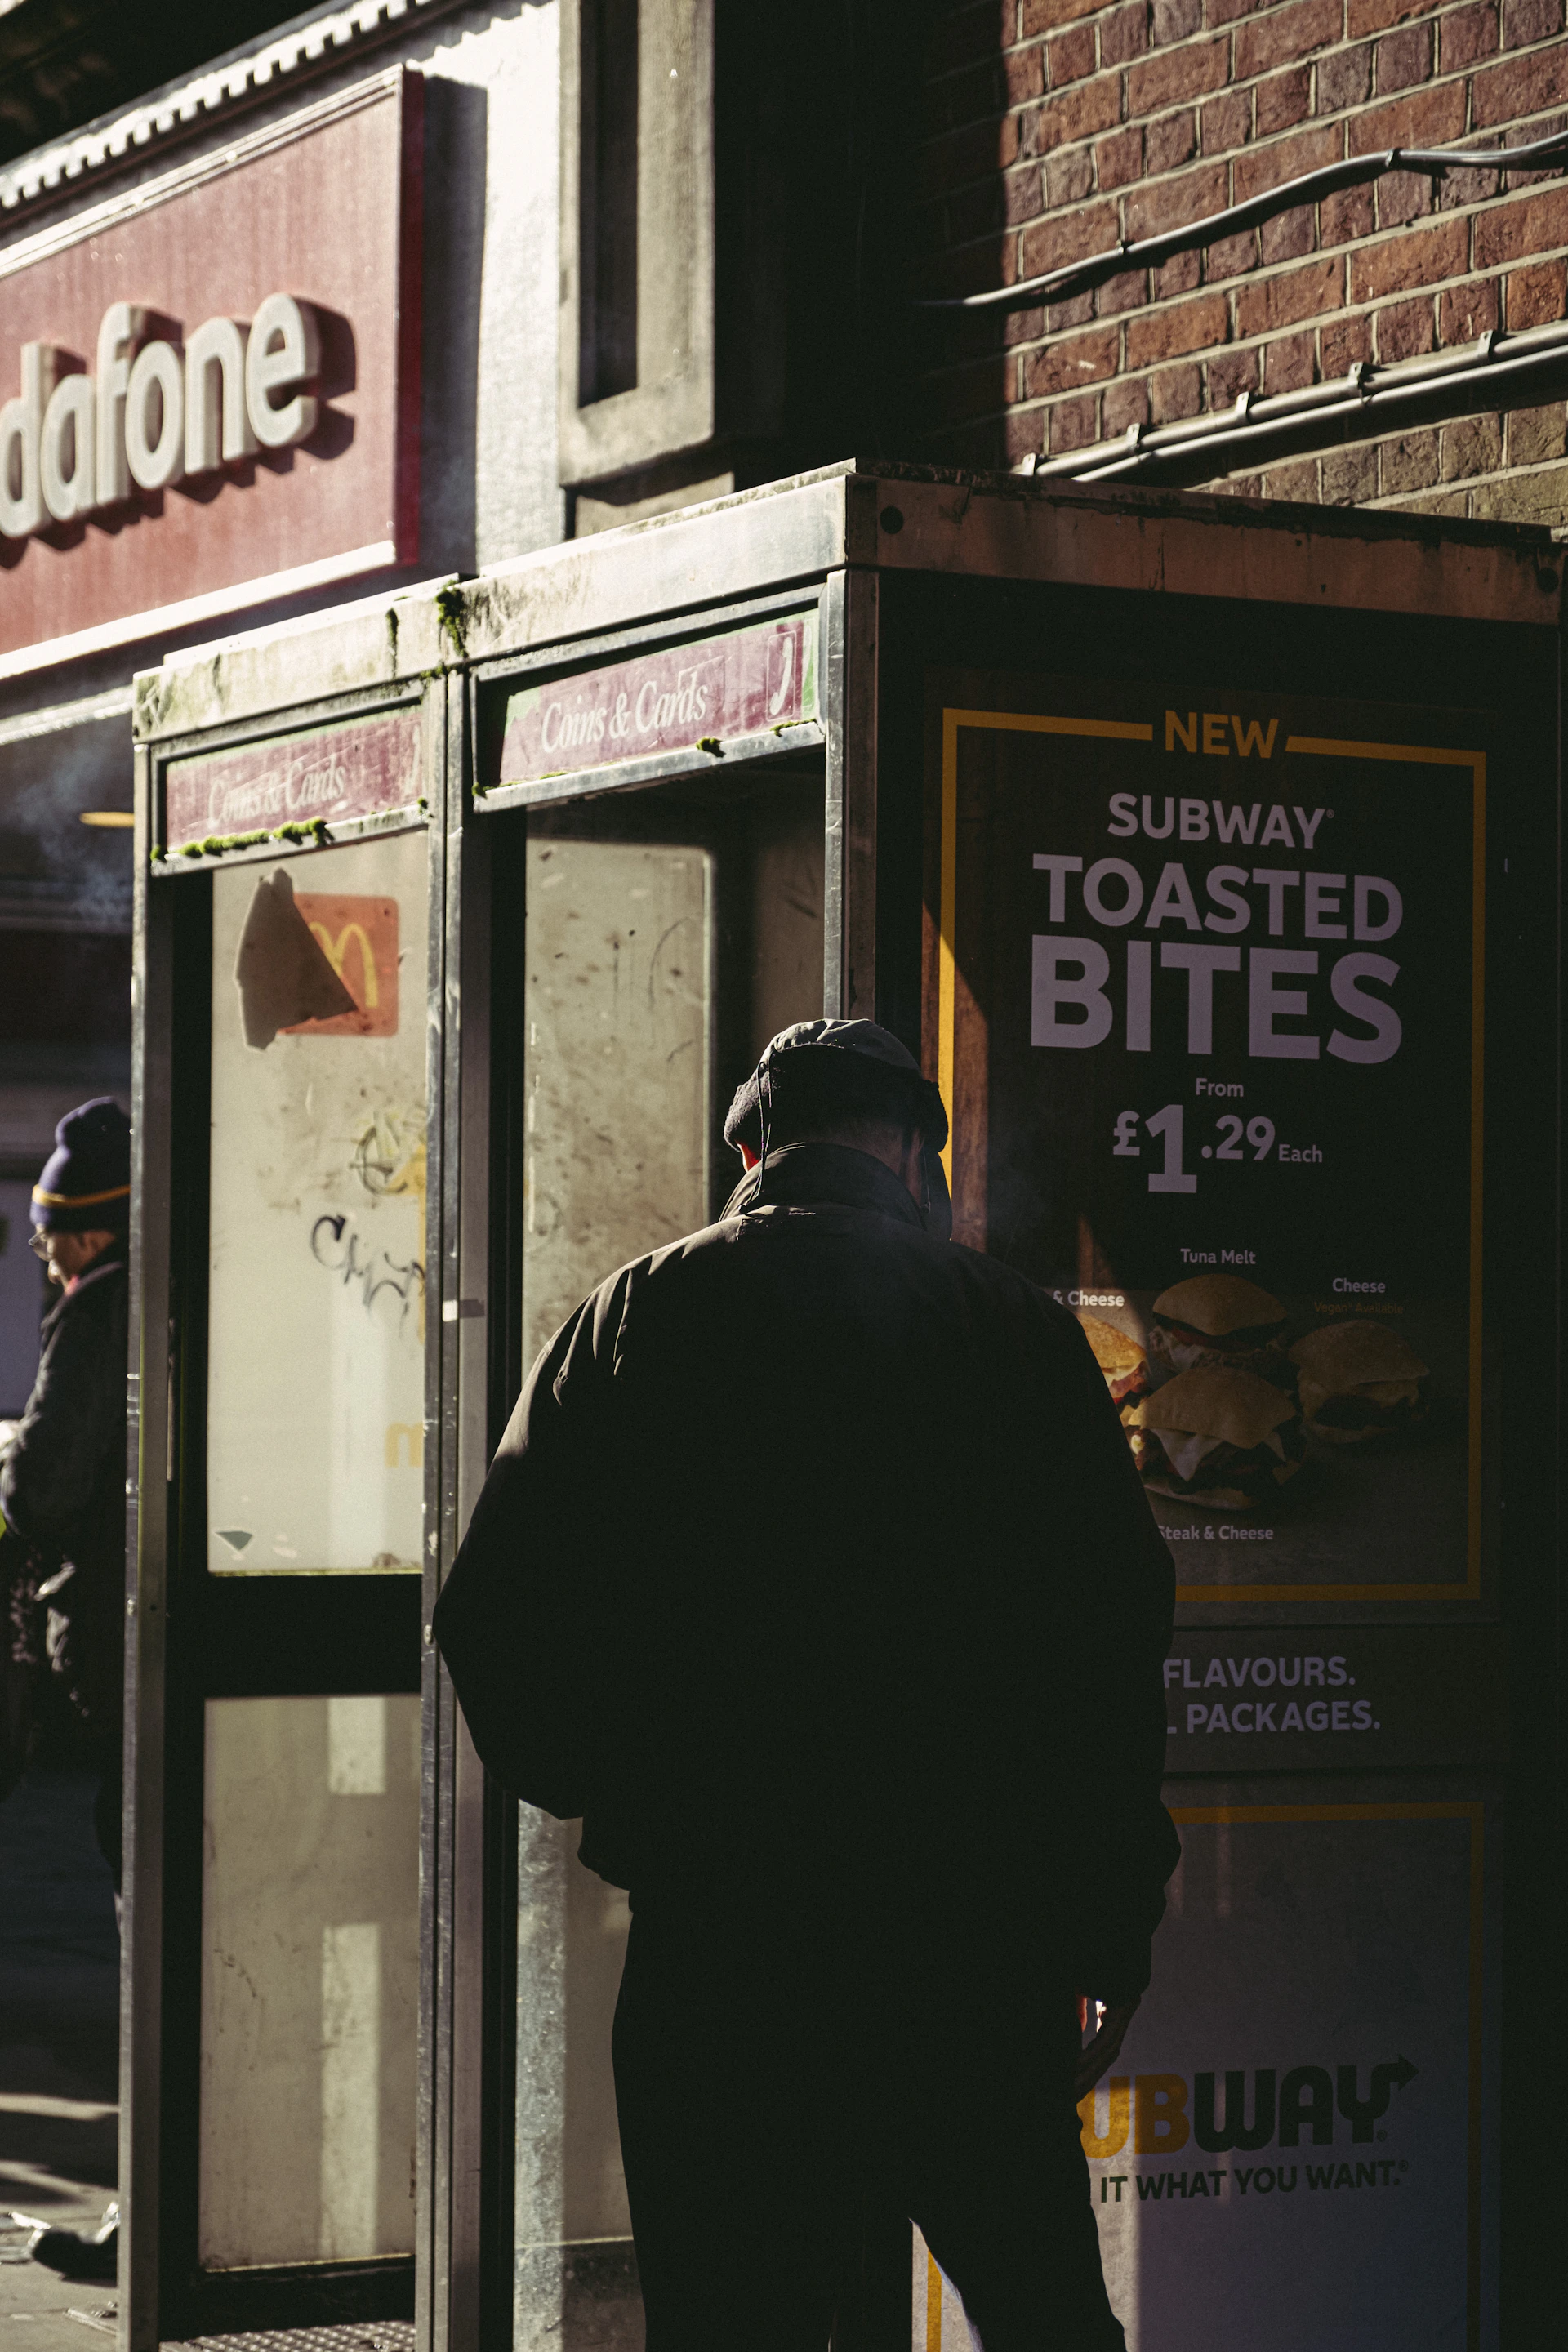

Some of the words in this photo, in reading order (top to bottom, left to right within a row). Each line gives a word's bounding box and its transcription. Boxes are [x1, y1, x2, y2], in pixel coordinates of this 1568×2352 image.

[541, 693, 606, 753] Coins
[609, 691, 631, 737] &
[635, 670, 709, 735] Cards
[1165, 710, 1280, 760] NEW
[285, 753, 346, 811] Cards
[1032, 853, 1404, 942] TOASTED
[1030, 933, 1403, 1065] BITES
[1195, 1077, 1245, 1098] From
[1112, 1103, 1276, 1194] £1.29
[1278, 1143, 1323, 1163] Each
[1180, 1248, 1218, 1264] Tuna
[1221, 1249, 1257, 1265] Melt
[1067, 1290, 1125, 1307] Cheese
[1331, 1276, 1387, 1294] Cheese
[1157, 1525, 1200, 1540] Steak
[1203, 1526, 1215, 1540] &
[1218, 1525, 1275, 1541] Cheese
[1162, 1655, 1356, 1689] FLAVOURS.
[1187, 1699, 1381, 1735] PACKAGES.
[1101, 2176, 1128, 2203] IT
[1135, 2170, 1227, 2201] WHAT
[1233, 2166, 1298, 2195] YOU
